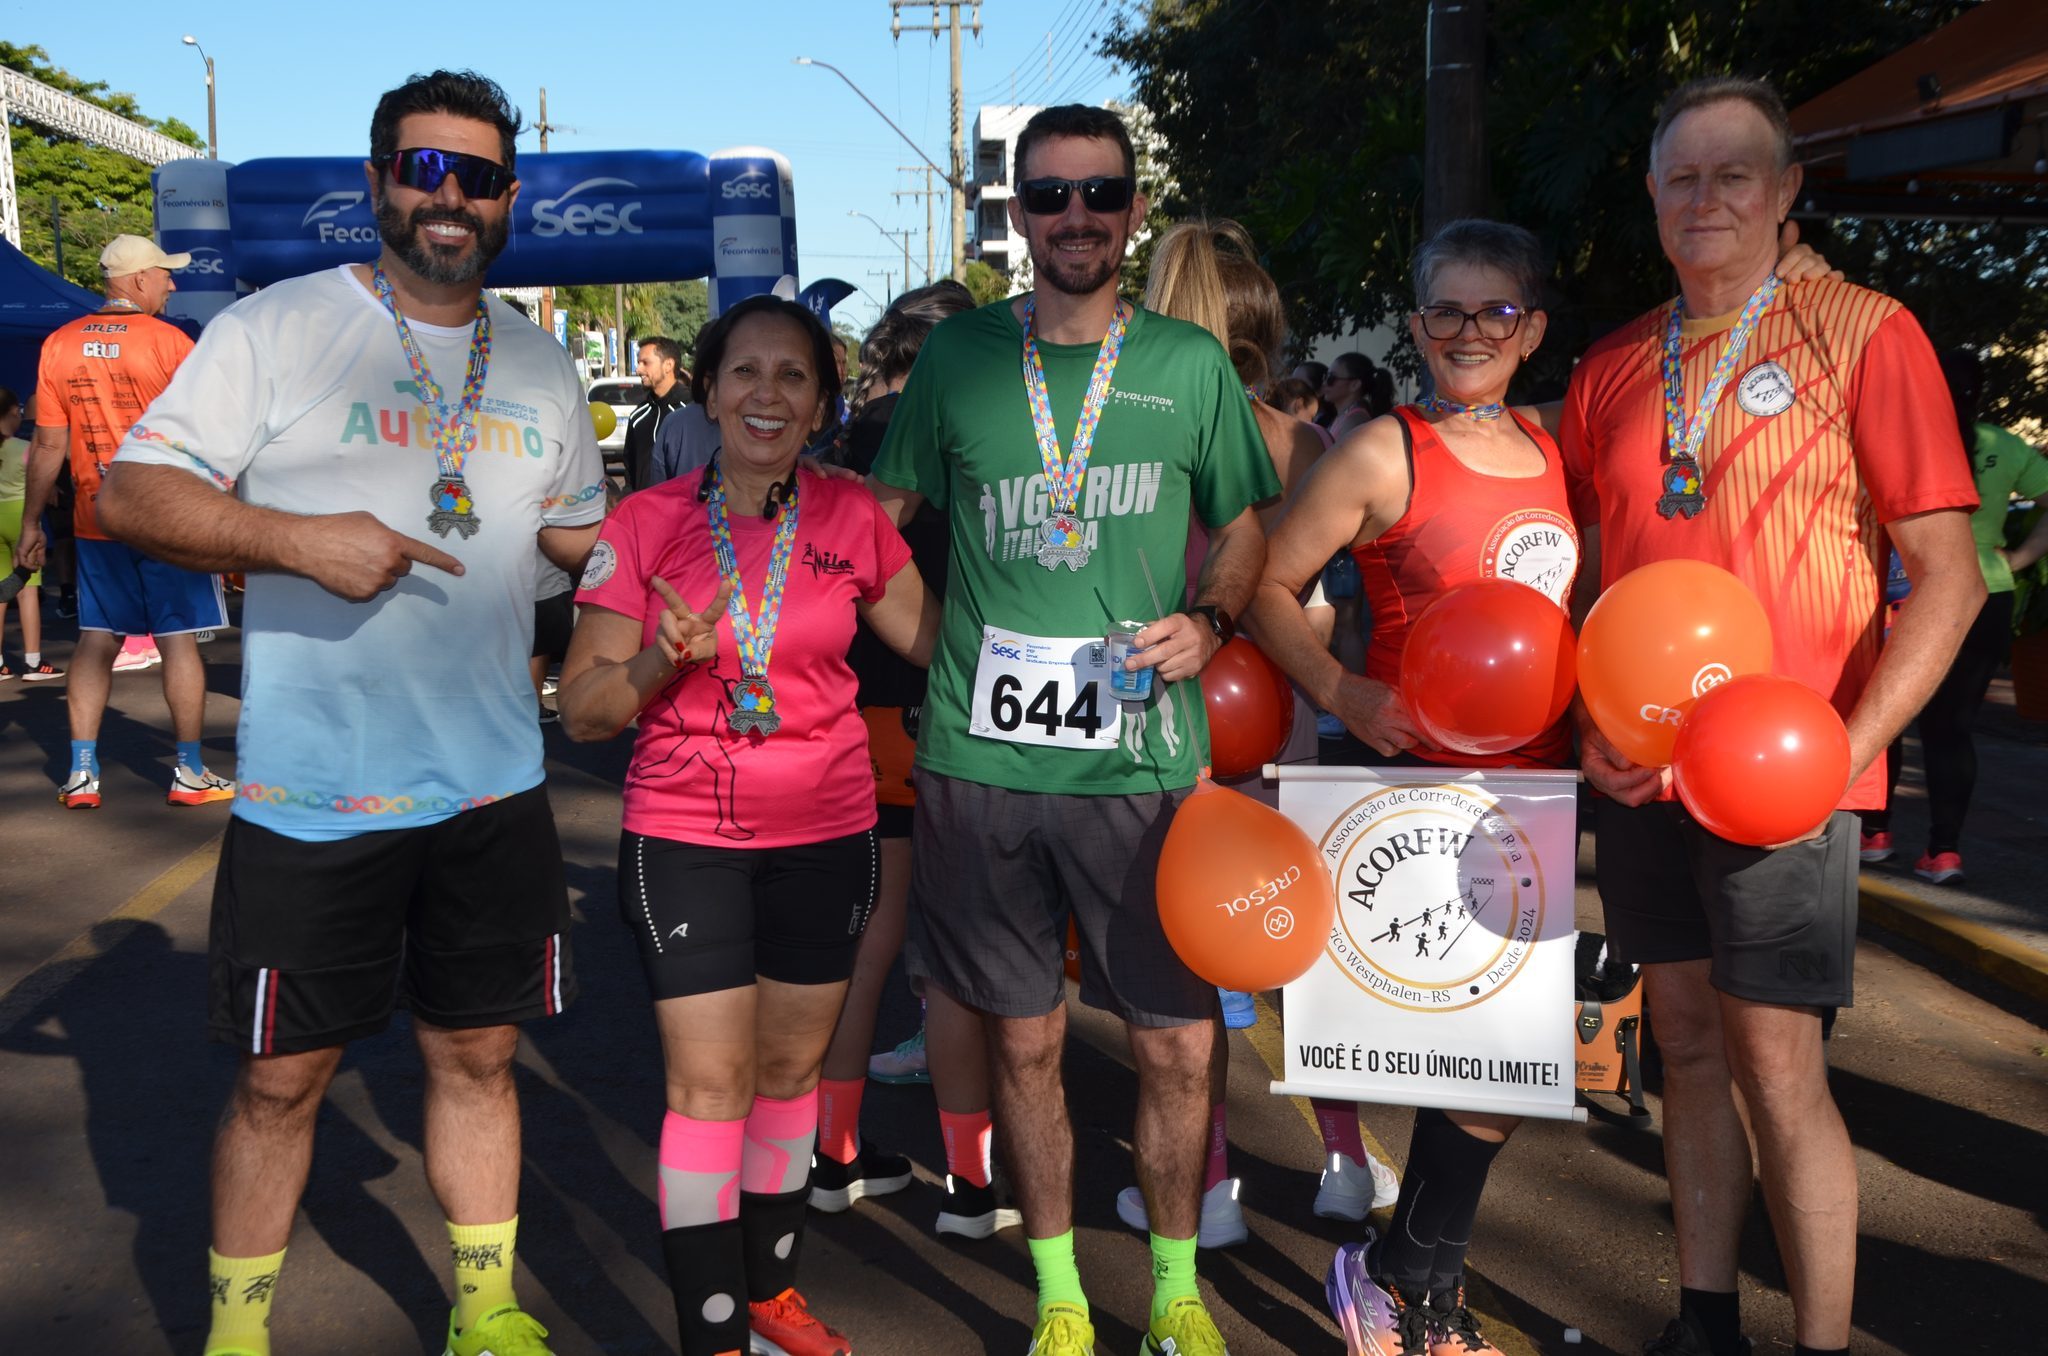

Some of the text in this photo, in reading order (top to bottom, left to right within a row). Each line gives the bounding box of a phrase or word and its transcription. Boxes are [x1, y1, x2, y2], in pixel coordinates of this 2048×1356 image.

[163, 199, 225, 208] Fecomércio RS
[722, 181, 771, 198] Sesc
[319, 223, 381, 244] Feco
[531, 199, 643, 237] Sesc
[722, 245, 769, 255] Fecomércio
[80, 324, 128, 333] ATLETA
[82, 341, 121, 359] CÉLIO
[1114, 399, 1175, 414] FITNESS
[1115, 390, 1174, 406] EVOLUTION
[340, 402, 544, 459] Autmo
[1083, 462, 1163, 519] RUN
[1501, 530, 1562, 578] ACORFW
[991, 642, 1021, 660] Sesc
[991, 674, 1102, 739] 644
[1326, 801, 1386, 859] Associação
[1388, 792, 1406, 806] de
[1409, 788, 1489, 821] Corredores
[1348, 827, 1475, 912] ACORFW
[1216, 865, 1300, 917] CRESOL
[1486, 908, 1537, 985] Desde 2024
[1299, 1043, 1346, 1070] VOCÊ
[1352, 1044, 1362, 1071] É
[1368, 1050, 1379, 1072] O
[1385, 1051, 1420, 1076] SEU
[1426, 1050, 1482, 1081] ÚNICO
[1488, 1059, 1559, 1087] LIMITE!
